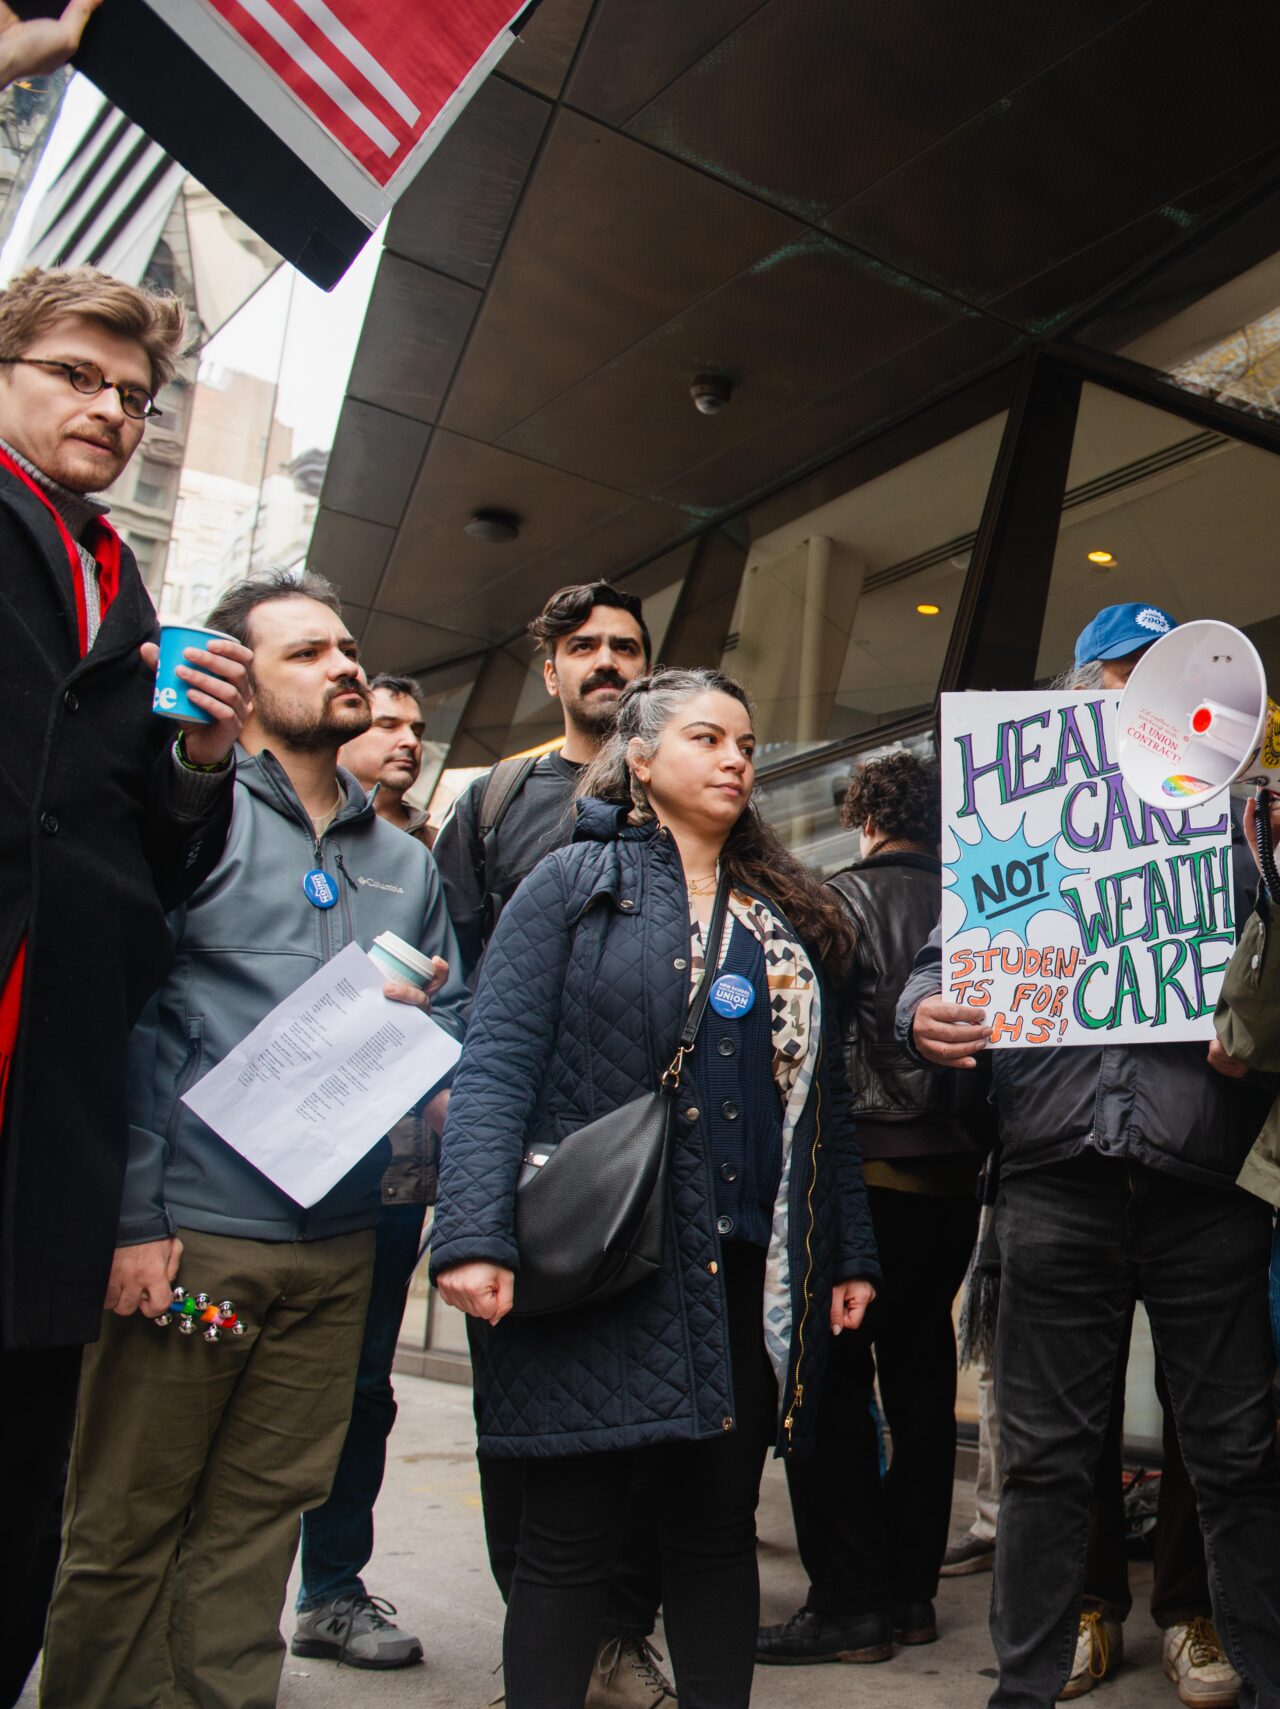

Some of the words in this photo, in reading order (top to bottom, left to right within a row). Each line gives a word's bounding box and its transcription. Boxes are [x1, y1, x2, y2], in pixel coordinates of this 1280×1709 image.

[1127, 727, 1181, 762] CONTRACT!
[1138, 722, 1147, 731] A
[1148, 727, 1178, 750] UNION
[954, 699, 1121, 818] HEAL
[366, 878, 404, 893] Columbia
[971, 852, 1049, 913] NOT
[1061, 846, 1235, 956] WEALTH
[716, 989, 748, 1005] UNION
[950, 979, 994, 1006] TS
[1010, 983, 1068, 1018] FOR
[1073, 931, 1234, 1030] CARE
[989, 1012, 1068, 1043] HS!
